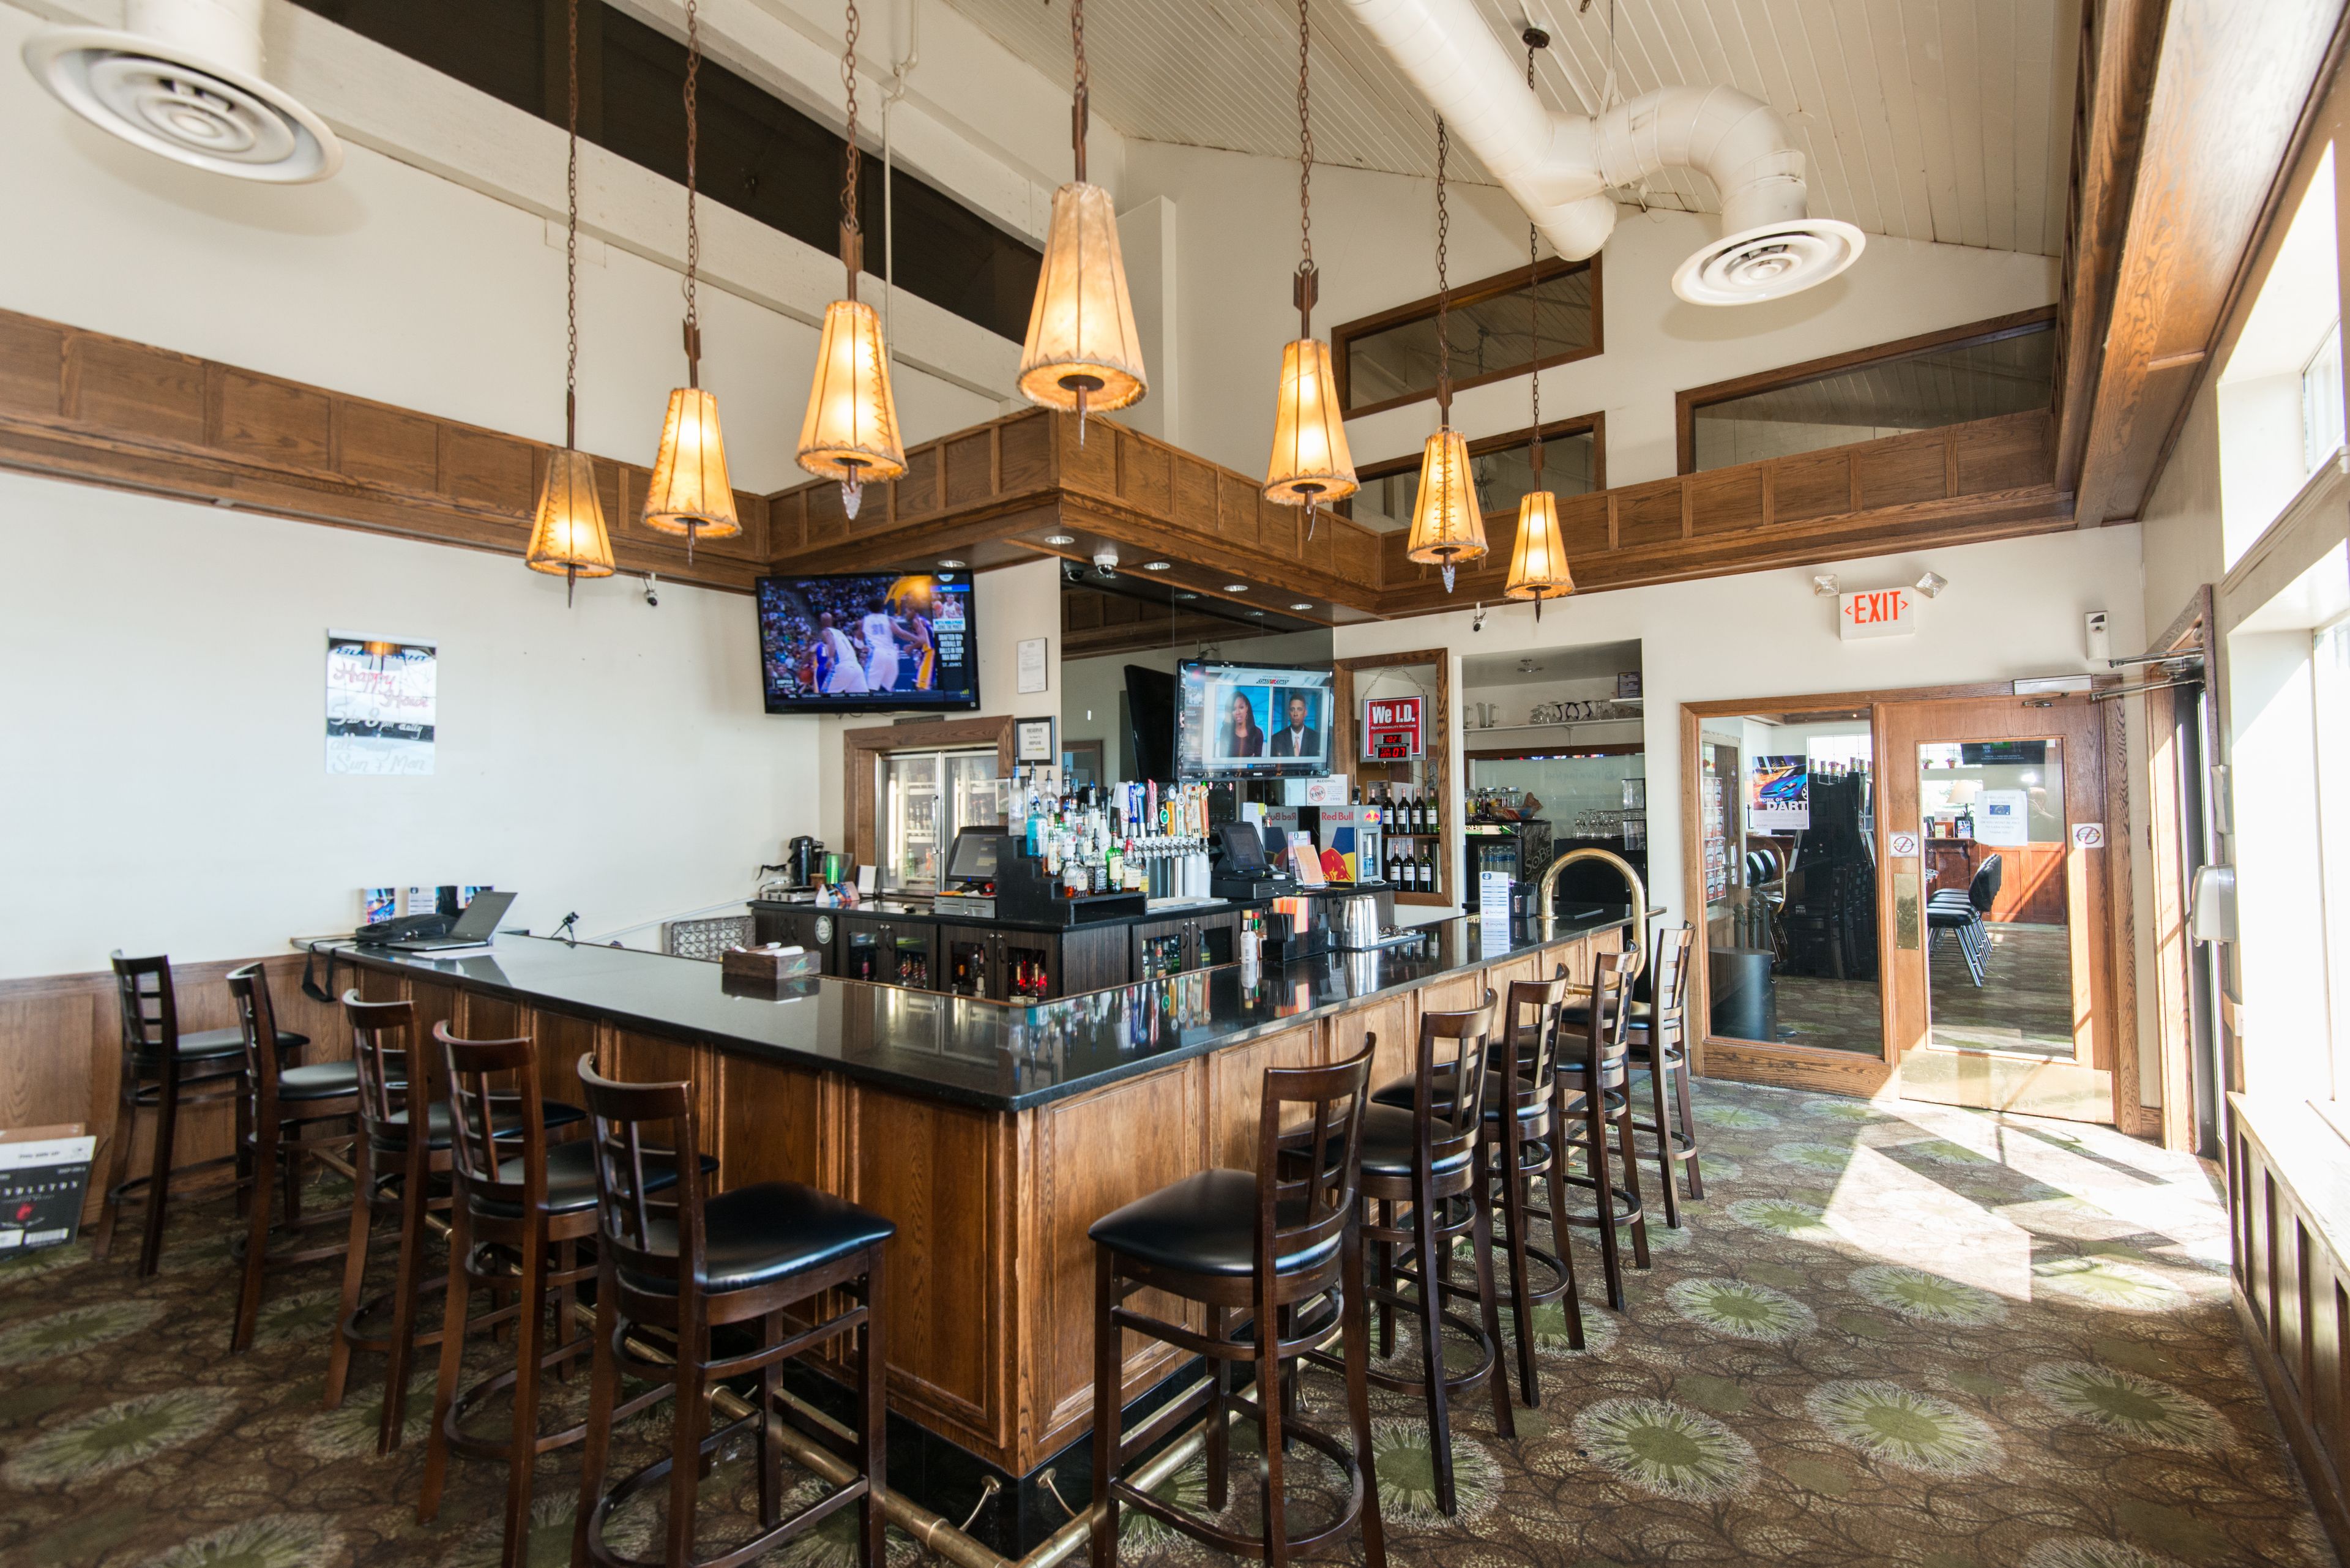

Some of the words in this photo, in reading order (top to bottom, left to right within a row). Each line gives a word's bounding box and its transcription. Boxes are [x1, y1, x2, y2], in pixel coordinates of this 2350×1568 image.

[1854, 591, 1901, 624] EXIT
[334, 662, 395, 693] Happy
[378, 690, 430, 708] Hour
[330, 703, 352, 726] 5
[365, 707, 381, 728] 8
[398, 722, 423, 739] daily
[1372, 706, 1392, 724] We
[1396, 704, 1416, 722] I.D.
[330, 733, 356, 751] all
[367, 733, 398, 761] day
[1392, 747, 1406, 757] 07
[333, 752, 370, 774] Sun
[389, 755, 426, 774] Mon
[1767, 801, 1807, 812] DART
[4, 1181, 78, 1196] NDLETON
